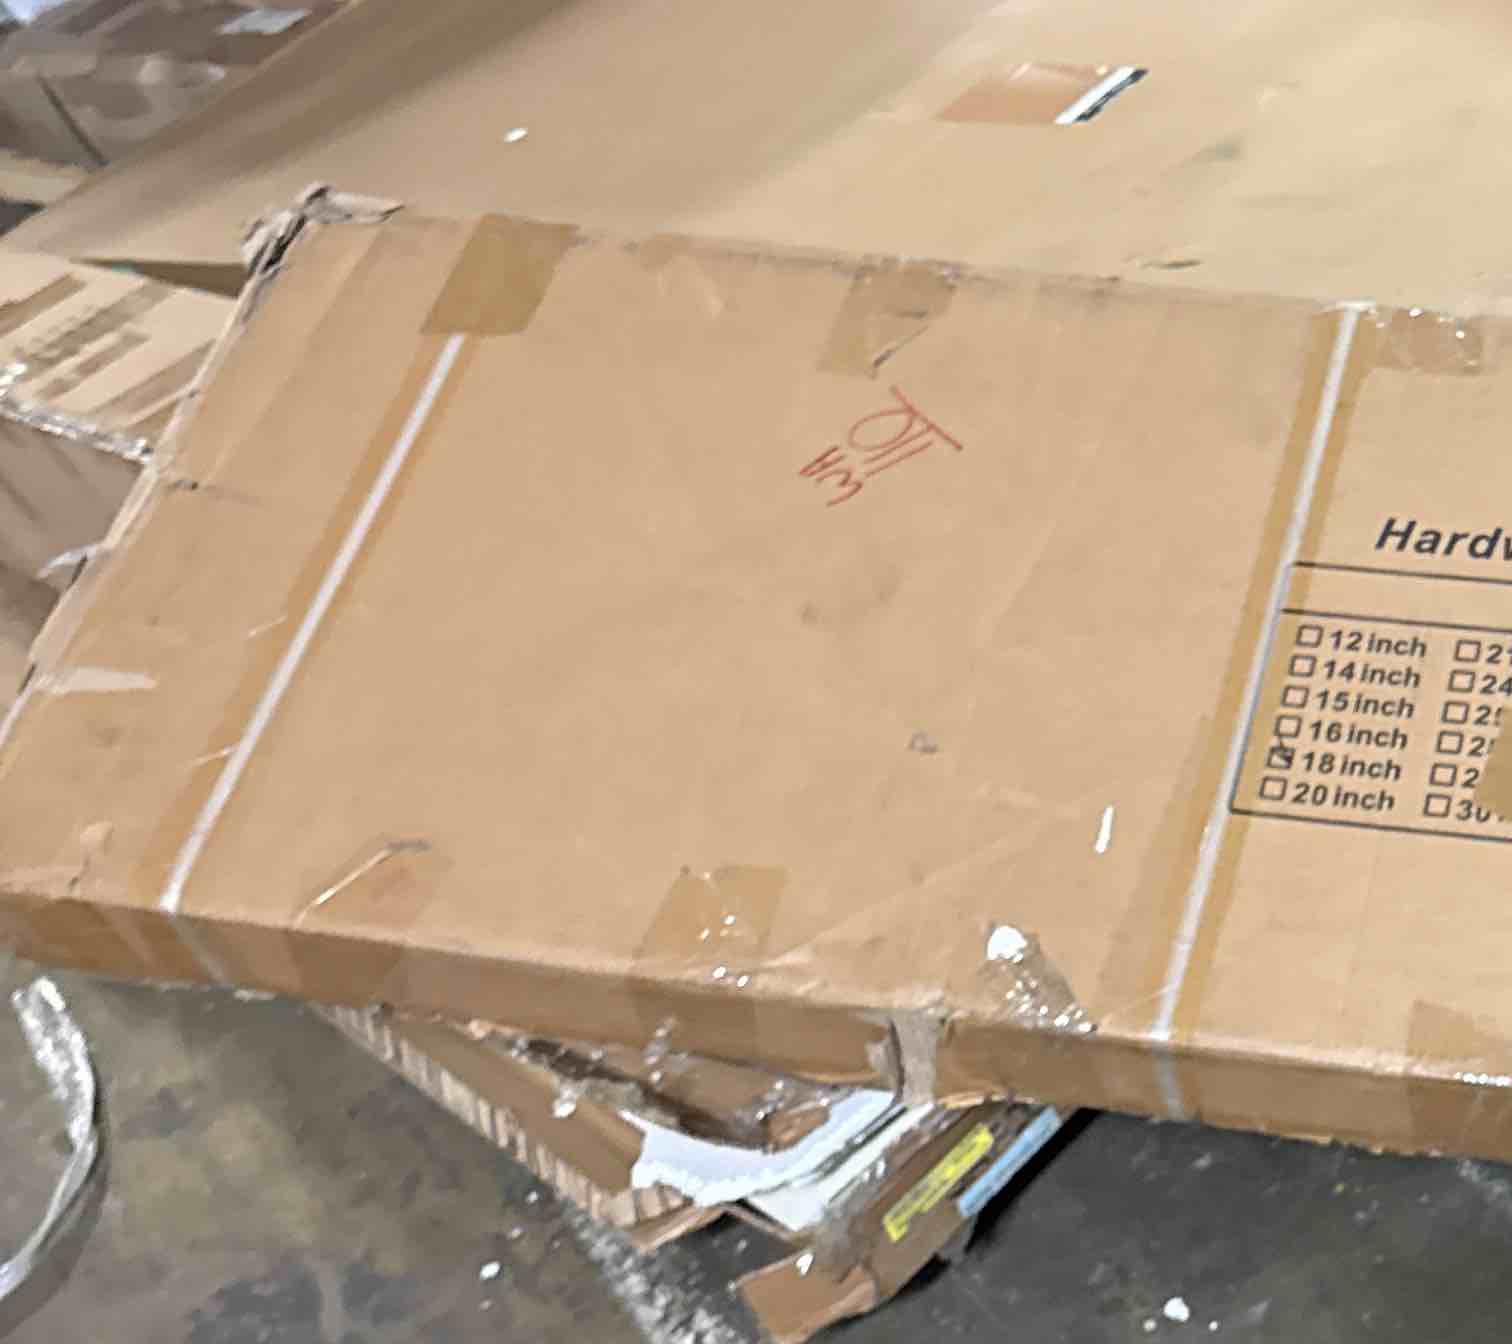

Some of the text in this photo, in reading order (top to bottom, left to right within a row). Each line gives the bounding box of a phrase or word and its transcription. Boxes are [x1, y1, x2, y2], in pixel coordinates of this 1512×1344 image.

[1329, 628, 1428, 659] 12 inch
[1323, 658, 1422, 689] 14 inch
[1315, 688, 1416, 719] 15 inch
[1309, 718, 1409, 751] 16 inch
[1302, 750, 1403, 782] 18 inch
[1289, 780, 1396, 812] 20 inch
